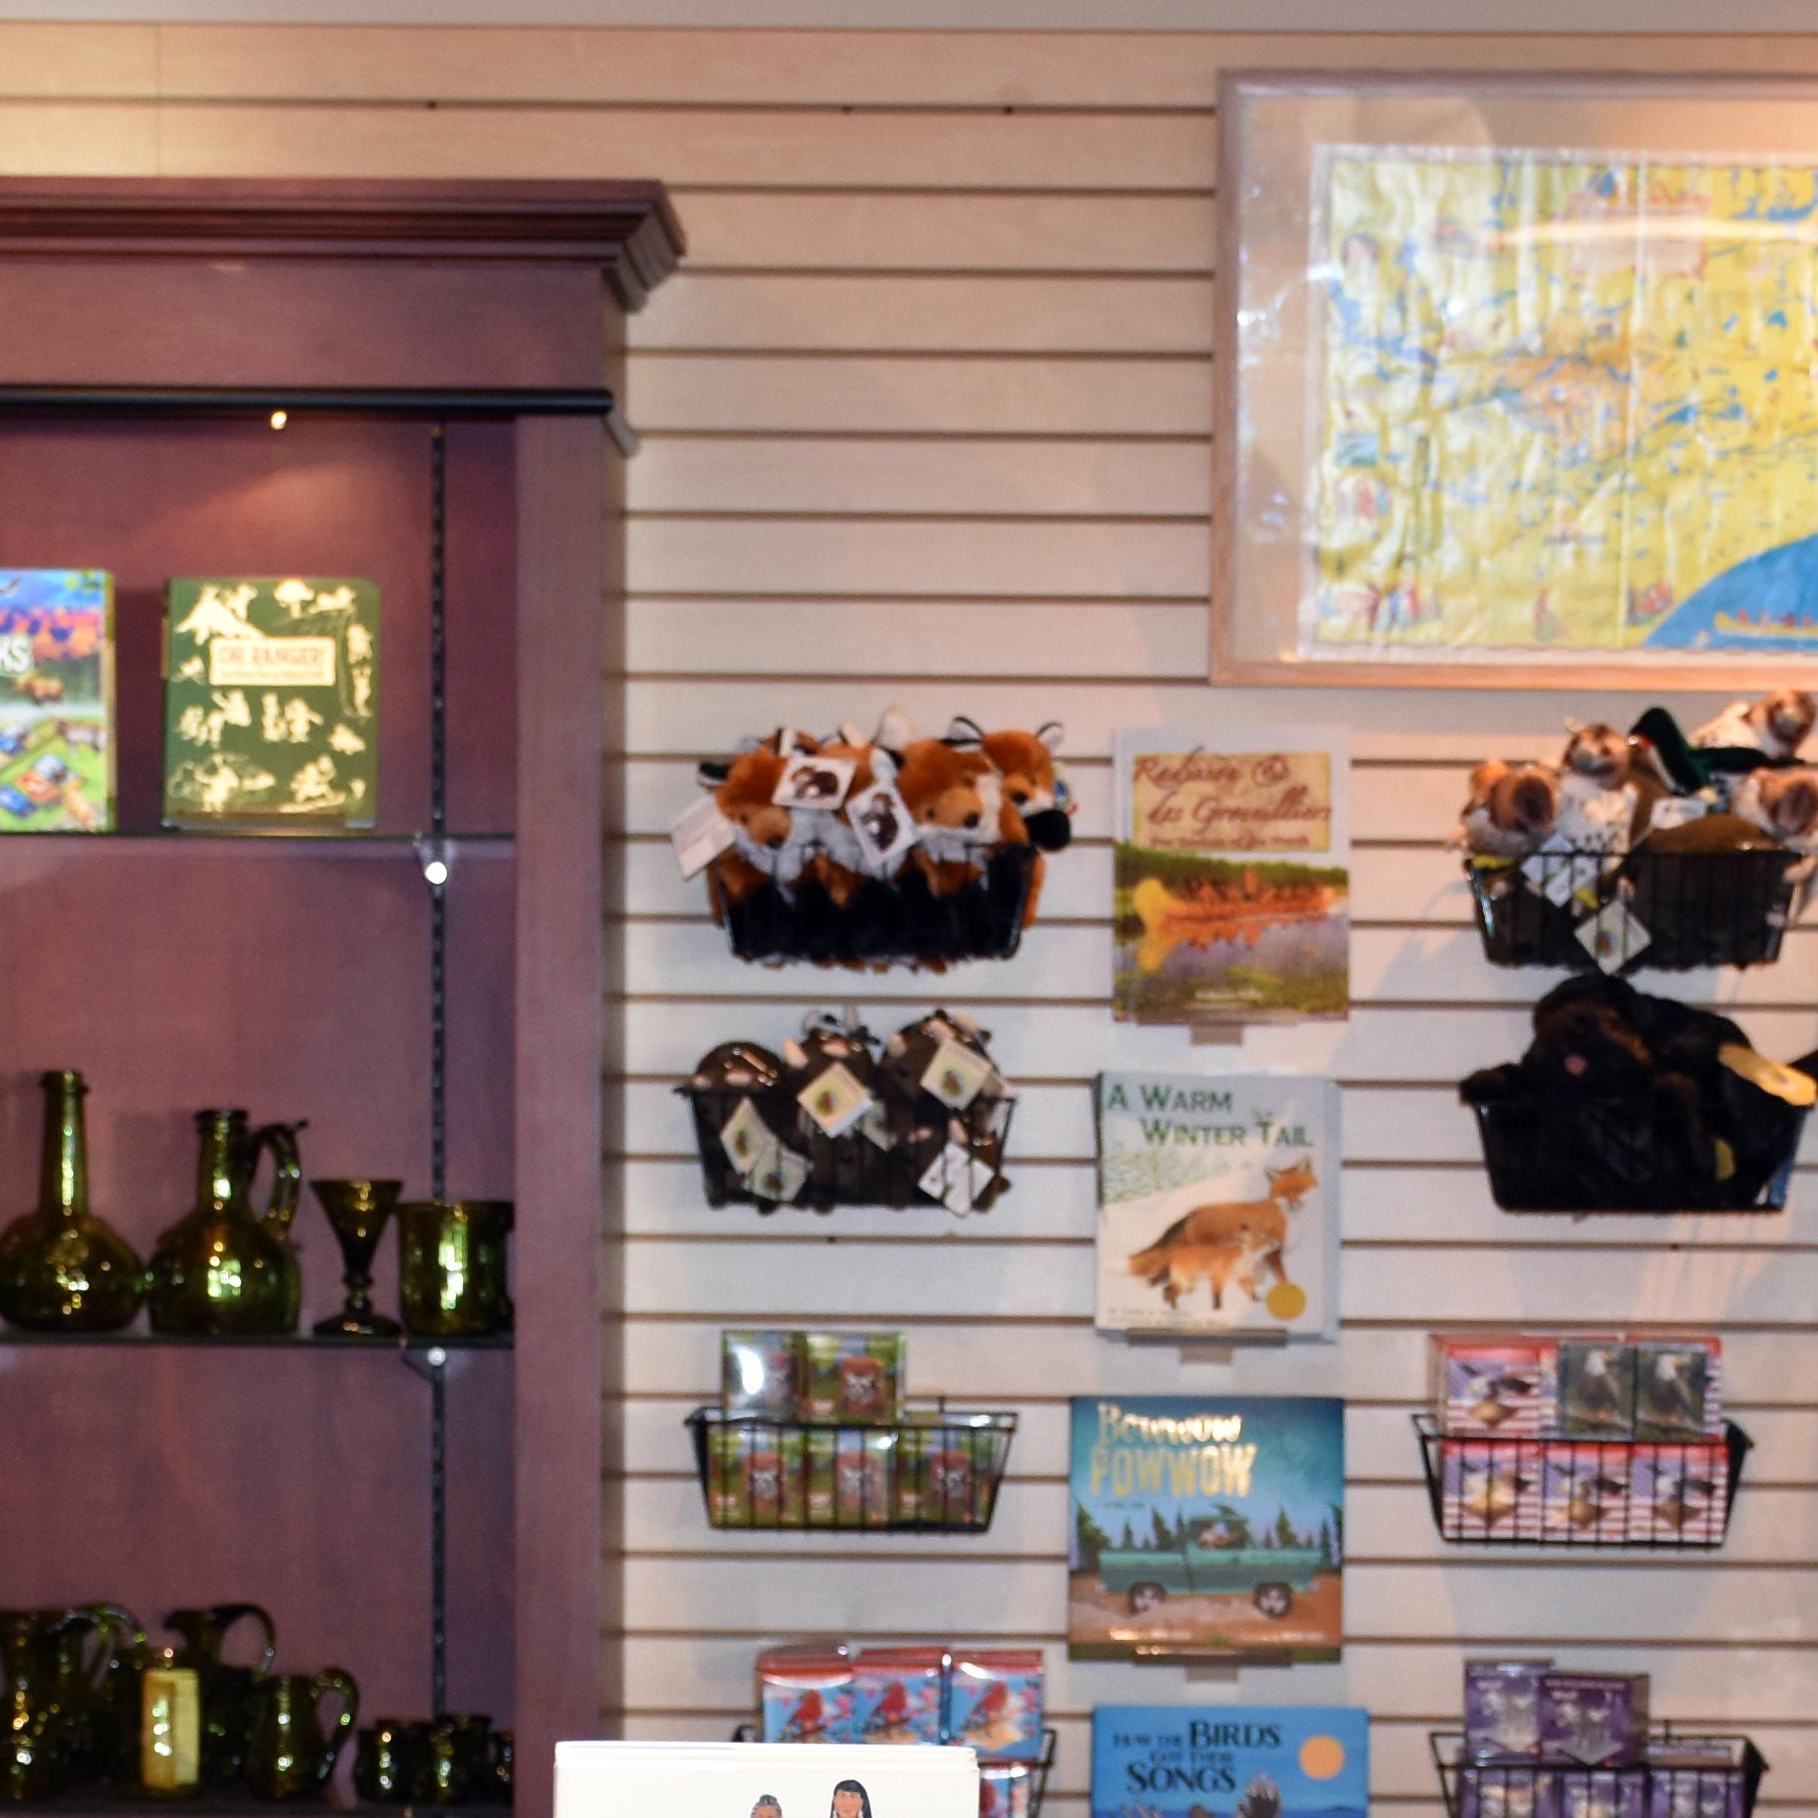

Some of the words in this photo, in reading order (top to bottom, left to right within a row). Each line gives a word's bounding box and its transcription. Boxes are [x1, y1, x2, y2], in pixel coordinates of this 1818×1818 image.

[1108, 1084, 1128, 1110] A
[1140, 1084, 1234, 1112] WARM
[1140, 1119, 1246, 1146] WINTER
[1256, 1115, 1313, 1147] TAIL
[1090, 1443, 1257, 1498] POWWOW
[1190, 1720, 1281, 1749] BIRDS
[1127, 1763, 1236, 1793] SONGS
